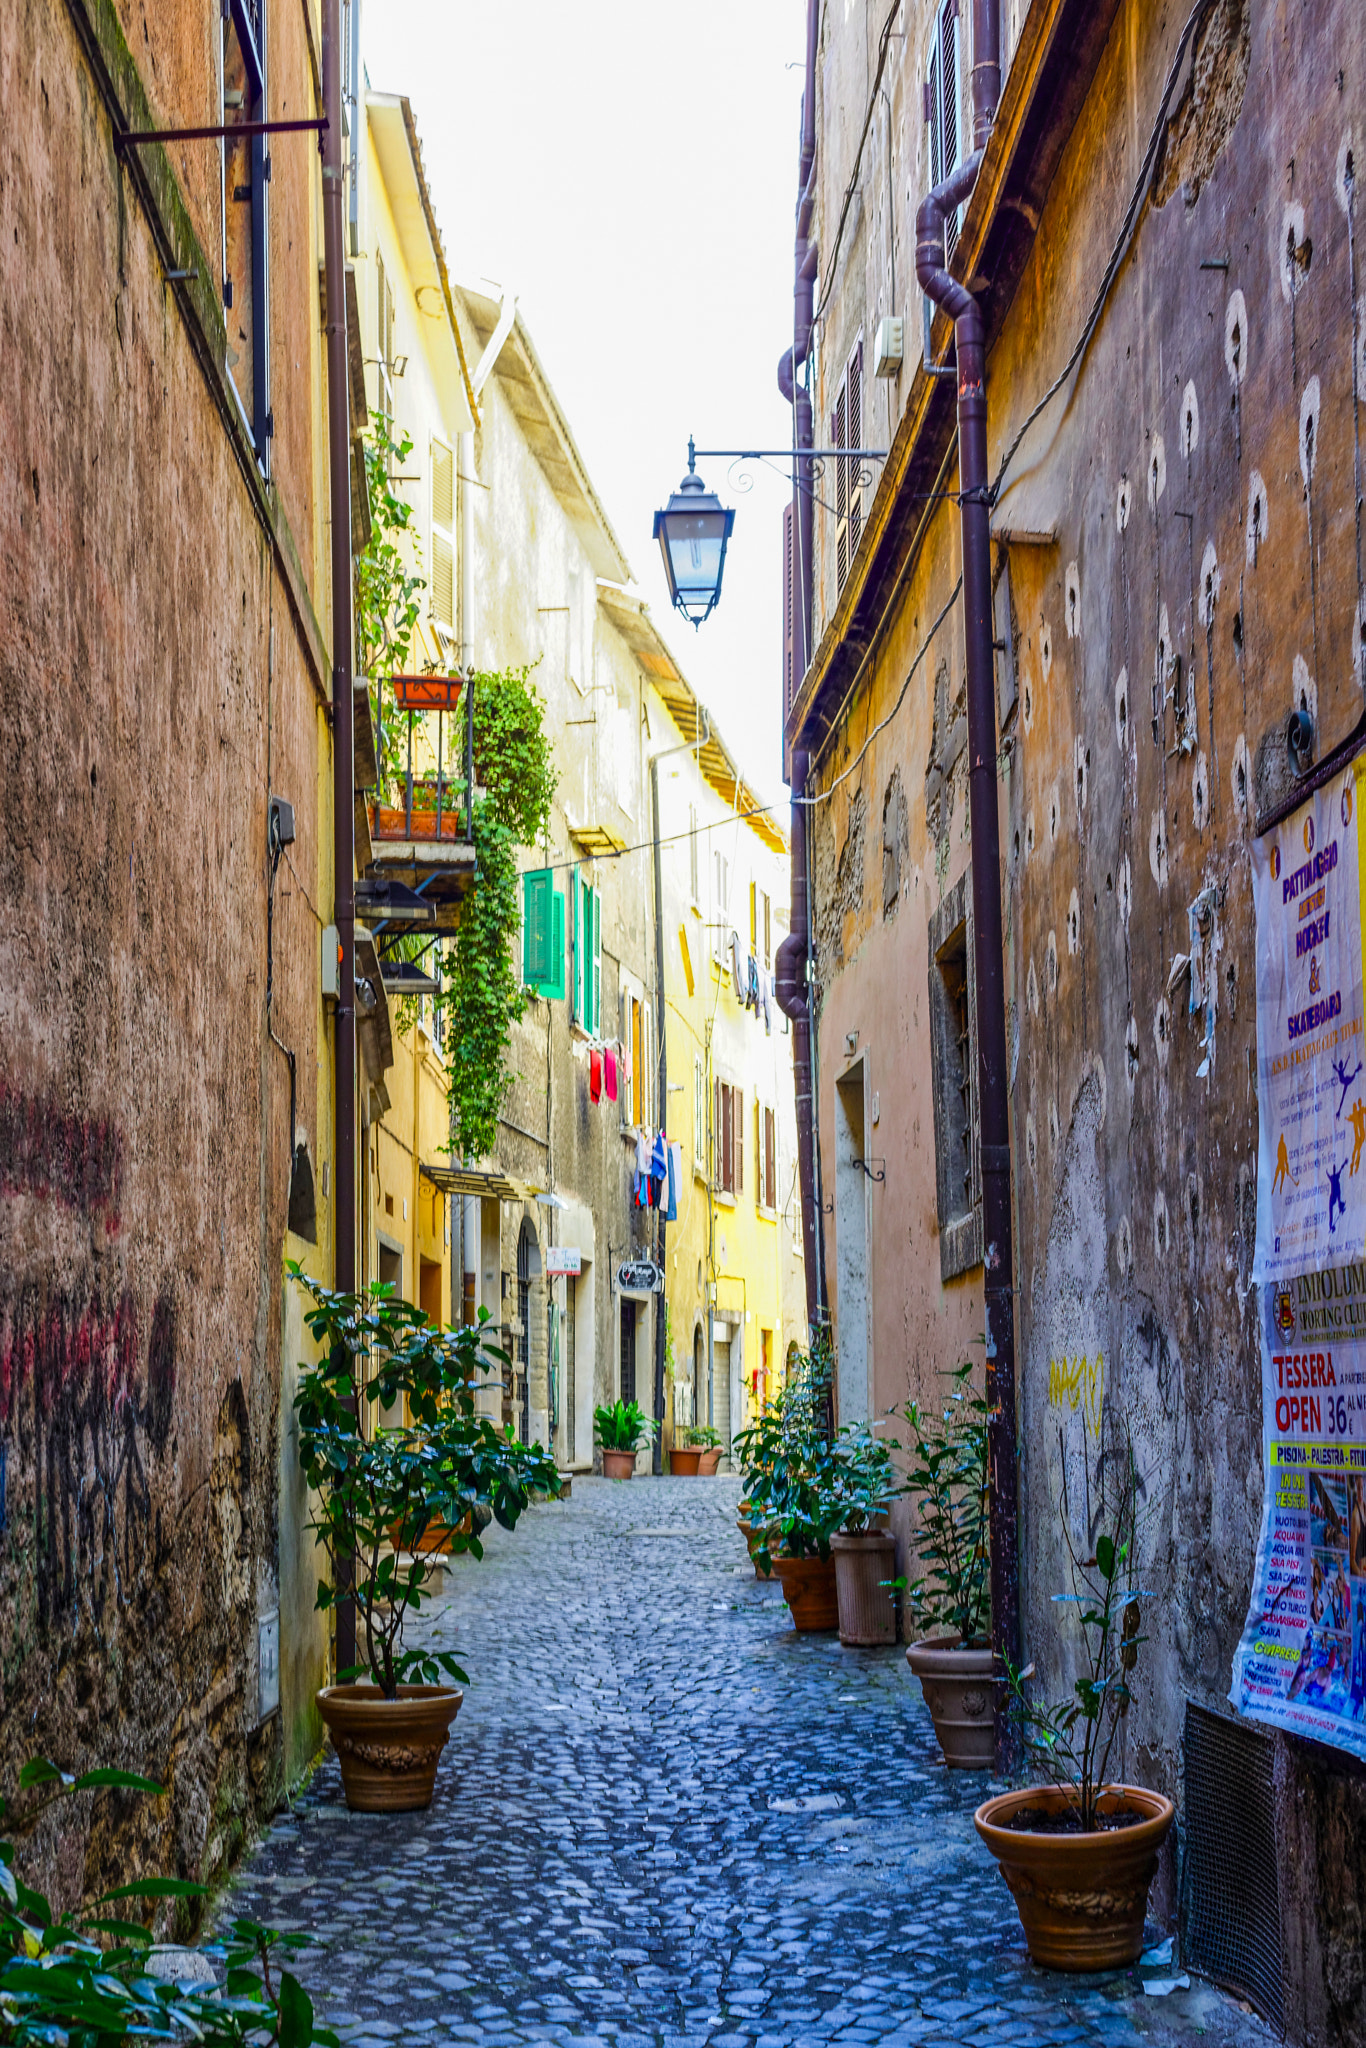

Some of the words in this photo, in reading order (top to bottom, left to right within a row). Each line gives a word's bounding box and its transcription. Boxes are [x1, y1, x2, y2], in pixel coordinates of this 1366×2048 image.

[1282, 840, 1338, 905] PATTINAGGIO
[1288, 990, 1342, 1040] SKATEBOARD
[1322, 1030, 1338, 1051] CLUB
[1300, 1306, 1342, 1331] SPORTING
[1273, 1352, 1336, 1388] TESSERA
[1348, 1395, 1356, 1410] AL
[1276, 1396, 1321, 1432] OPEN
[1328, 1395, 1347, 1434] 36
[1349, 1418, 1353, 1435] €
[1277, 1446, 1306, 1463] PISCINA
[1311, 1447, 1344, 1466] PALESTRA
[1280, 1473, 1291, 1489] IN
[1292, 1473, 1305, 1490] UNA
[1274, 1530, 1295, 1542] ACQUA
[1272, 1544, 1294, 1556] ACQUA
[1288, 1602, 1307, 1614] TURCO
